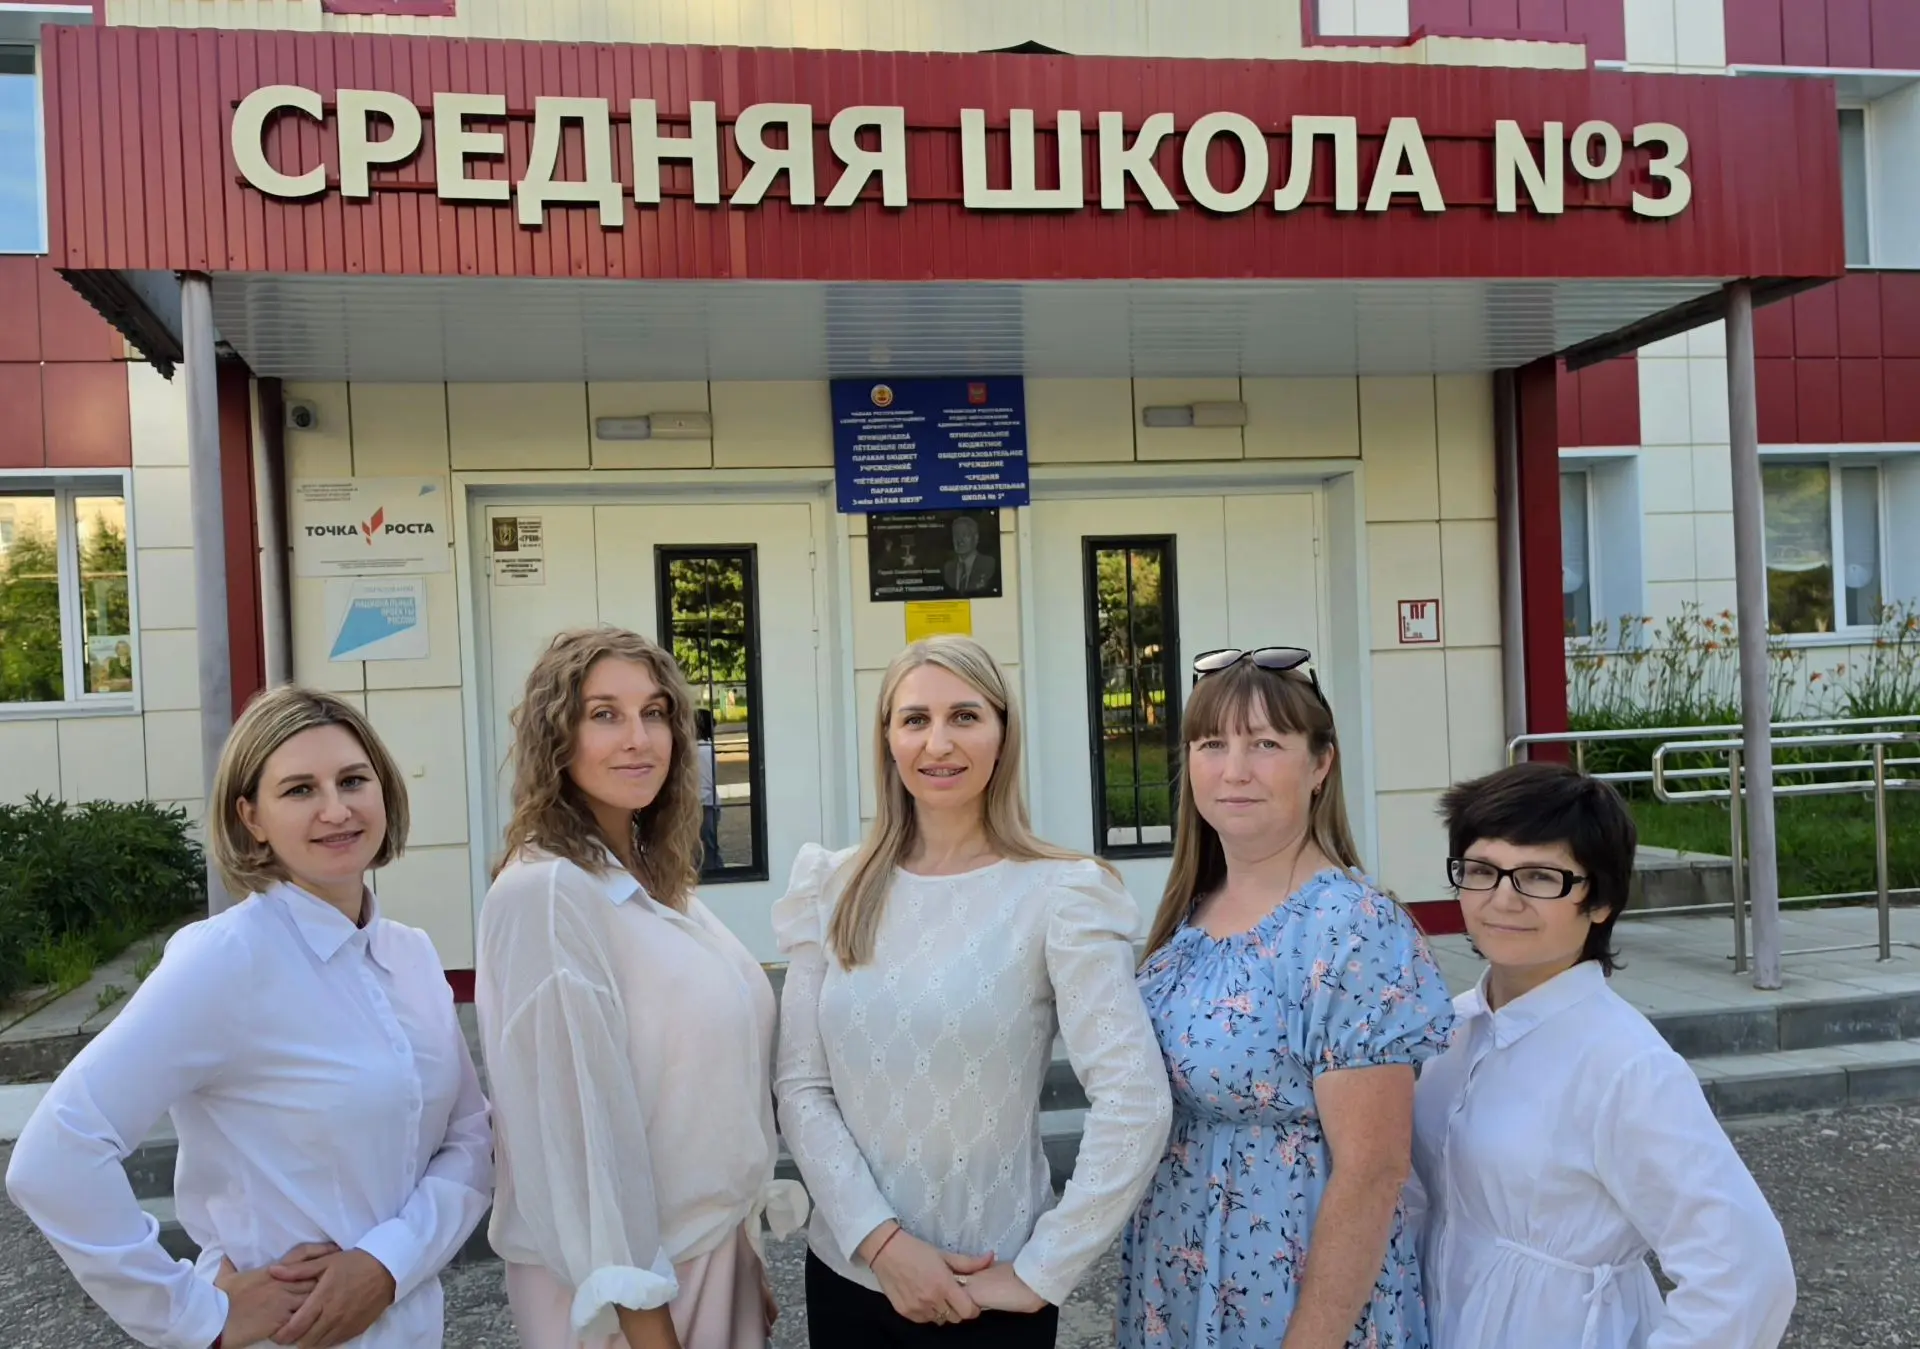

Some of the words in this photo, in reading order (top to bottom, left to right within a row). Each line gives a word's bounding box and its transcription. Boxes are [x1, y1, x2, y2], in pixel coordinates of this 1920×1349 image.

[231, 85, 908, 226] СРЕДНЯЯ
[960, 108, 1446, 212] ШКОЛА
[305, 524, 358, 537] ТОЧКА
[385, 523, 435, 535] РОСТА
[1410, 602, 1427, 620] ПГ
